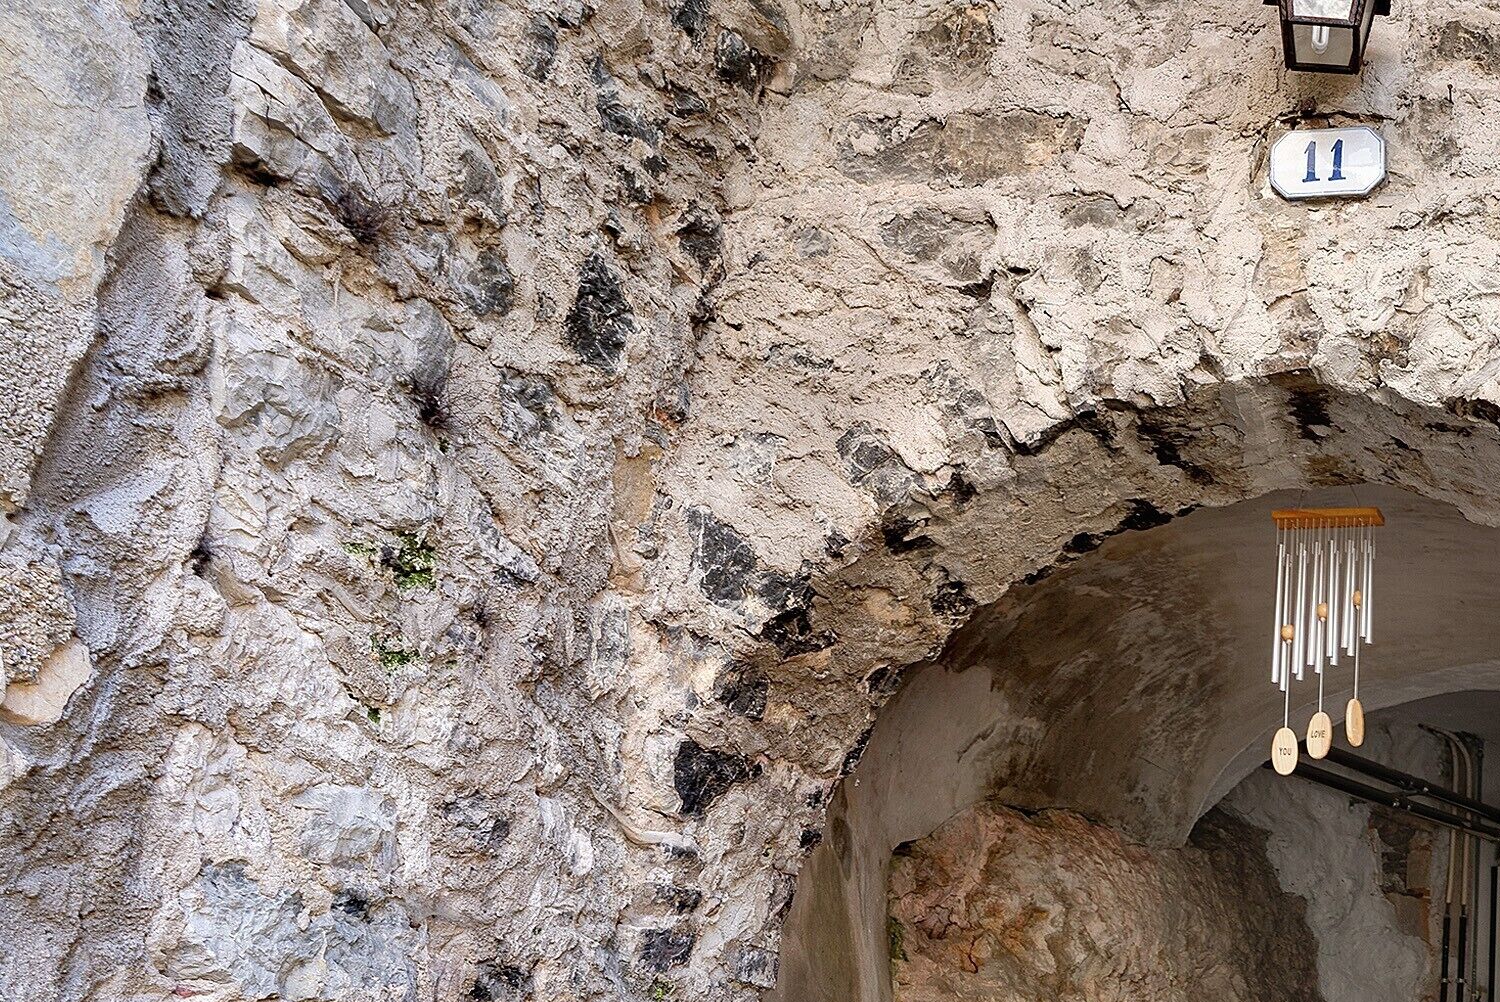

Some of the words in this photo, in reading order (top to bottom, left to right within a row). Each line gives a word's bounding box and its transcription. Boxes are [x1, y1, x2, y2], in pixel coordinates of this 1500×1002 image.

[1302, 139, 1346, 183] 11
[1310, 730, 1326, 739] LOVE
[1279, 747, 1292, 756] YOU
